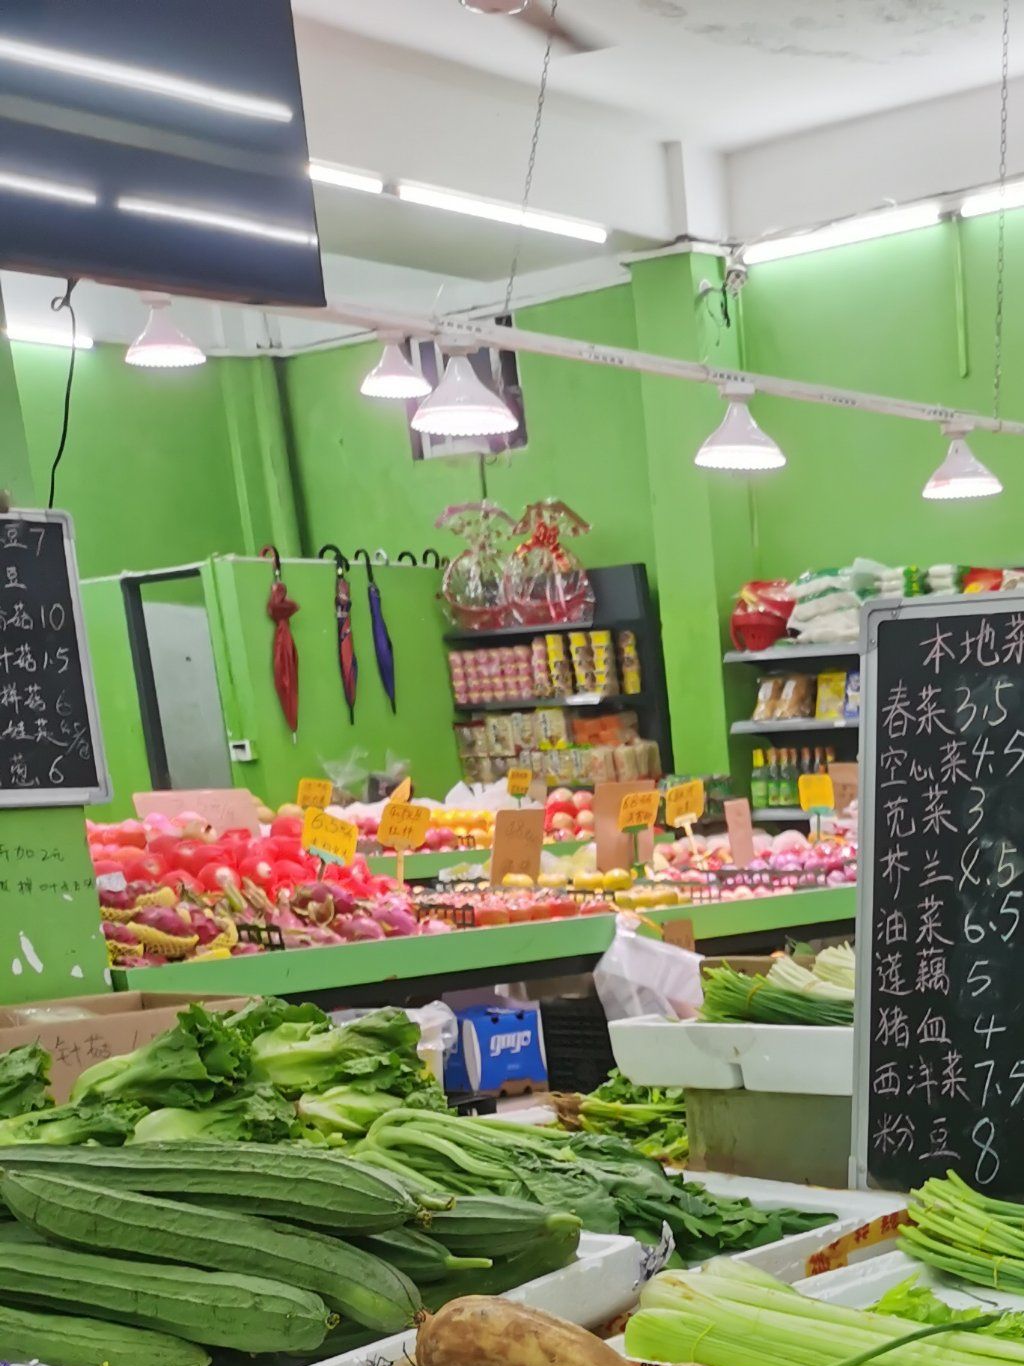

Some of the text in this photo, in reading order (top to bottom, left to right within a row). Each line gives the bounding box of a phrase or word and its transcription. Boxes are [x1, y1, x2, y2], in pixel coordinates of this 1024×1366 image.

[41, 603, 65, 631] 10
[881, 679, 955, 738] 春菜
[880, 739, 972, 788] 空心菜
[967, 786, 985, 834] 3
[877, 894, 954, 945] 油菜
[876, 947, 991, 997] 莲藕 5
[875, 1005, 1007, 1050] 猪血 4
[872, 1112, 1000, 1185] 粉豆 8
